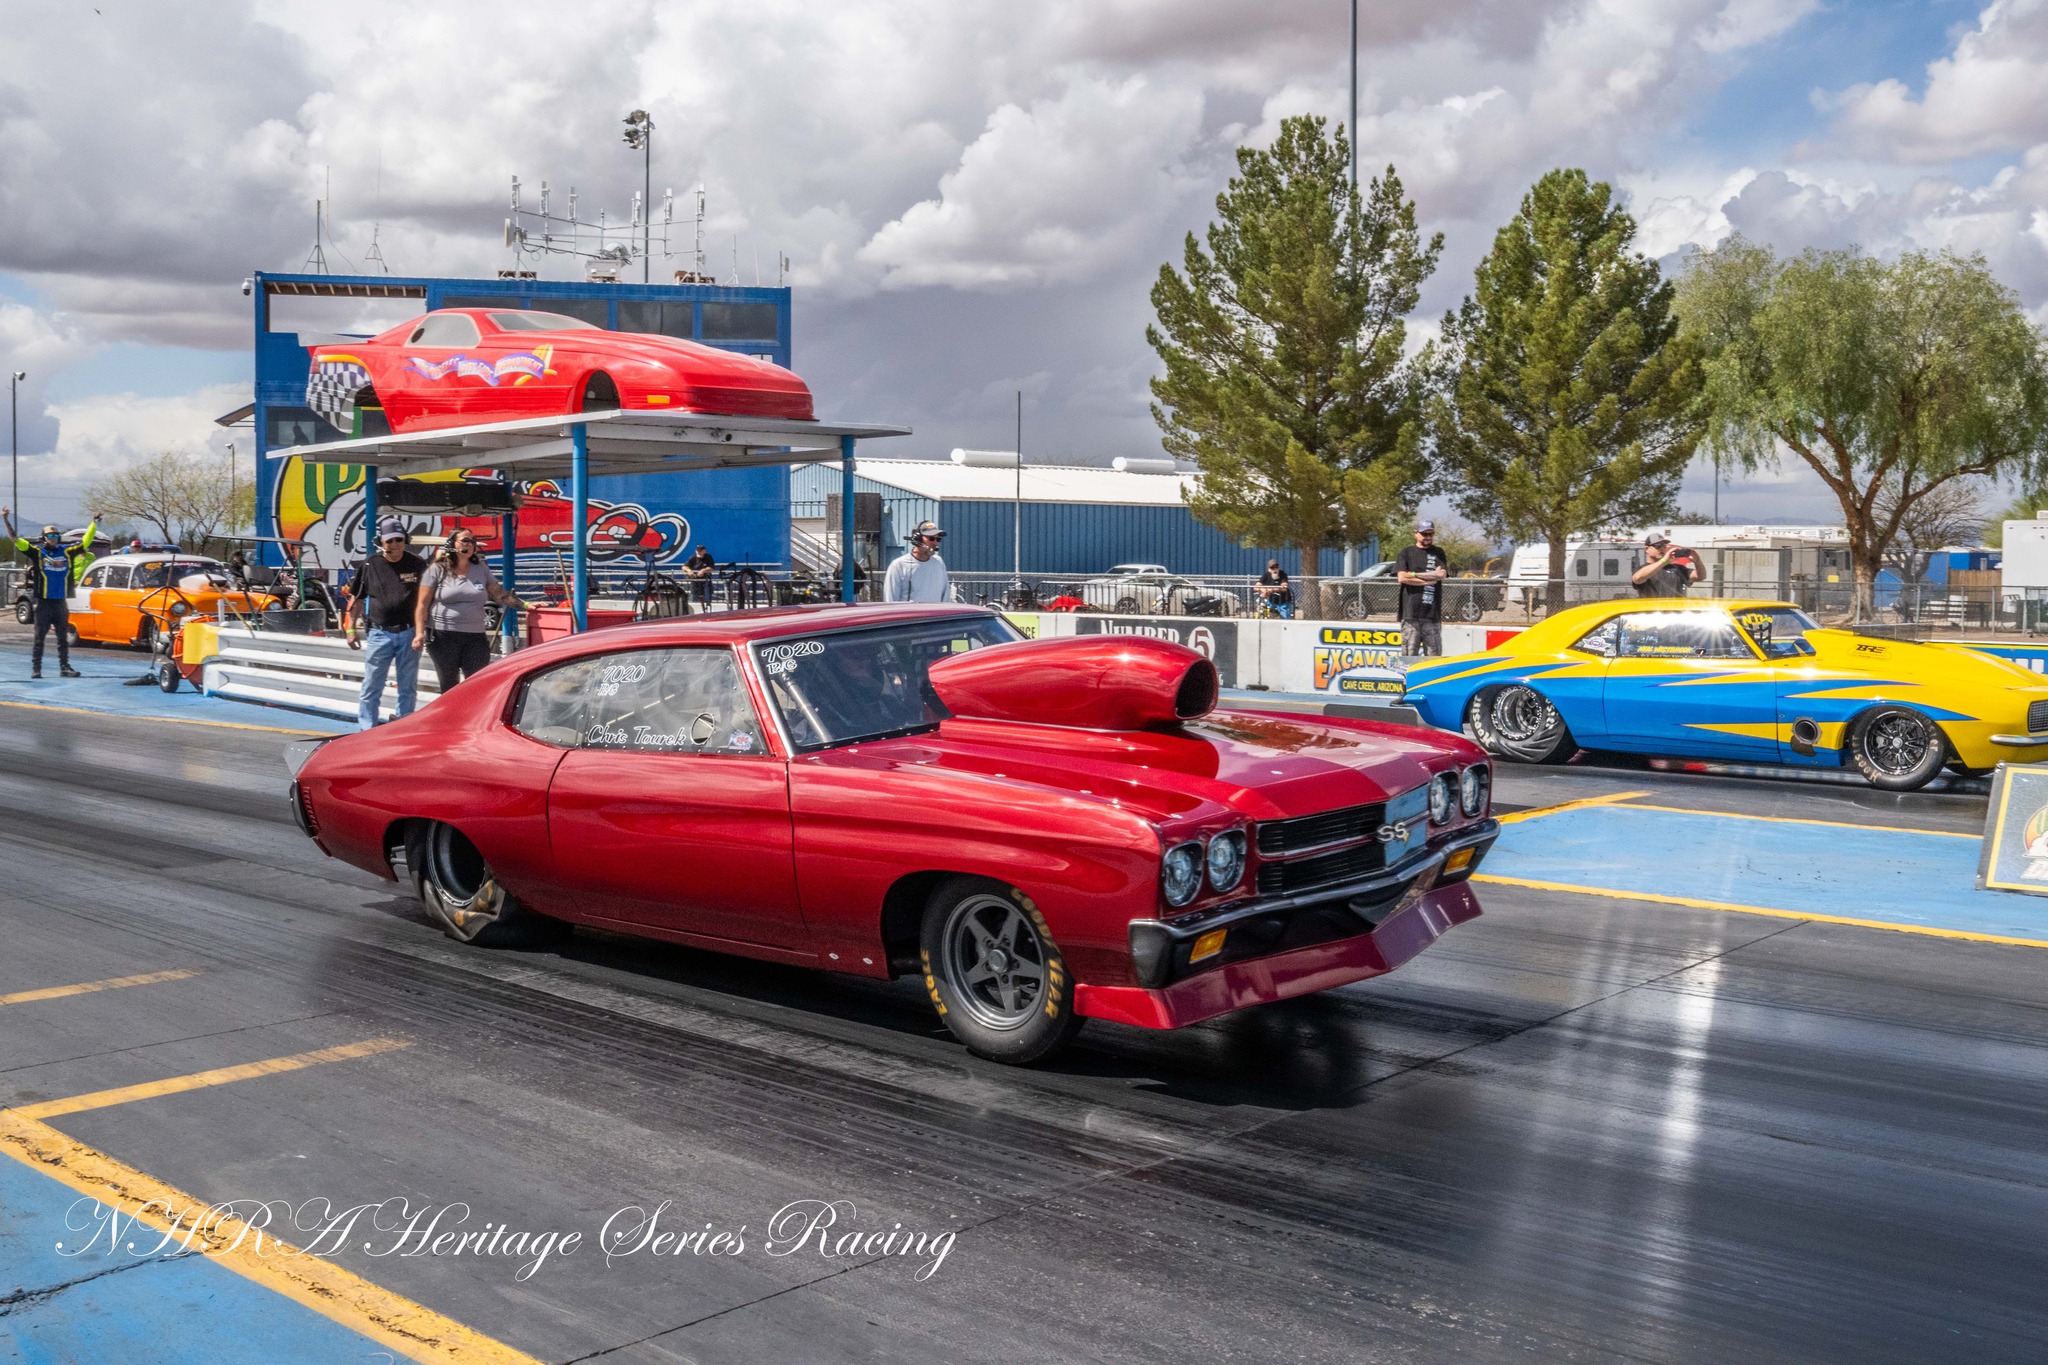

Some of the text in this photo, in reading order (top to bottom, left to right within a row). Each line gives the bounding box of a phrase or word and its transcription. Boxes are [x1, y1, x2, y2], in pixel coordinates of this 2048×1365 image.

[1324, 630, 1402, 645] LARSO
[761, 641, 825, 662] 7020
[603, 665, 646, 683] 7020
[1343, 680, 1358, 690] CAVE
[1377, 681, 1403, 693] ARIZONA
[588, 725, 687, 746] Chris Tourek
[1378, 822, 1407, 842] SS
